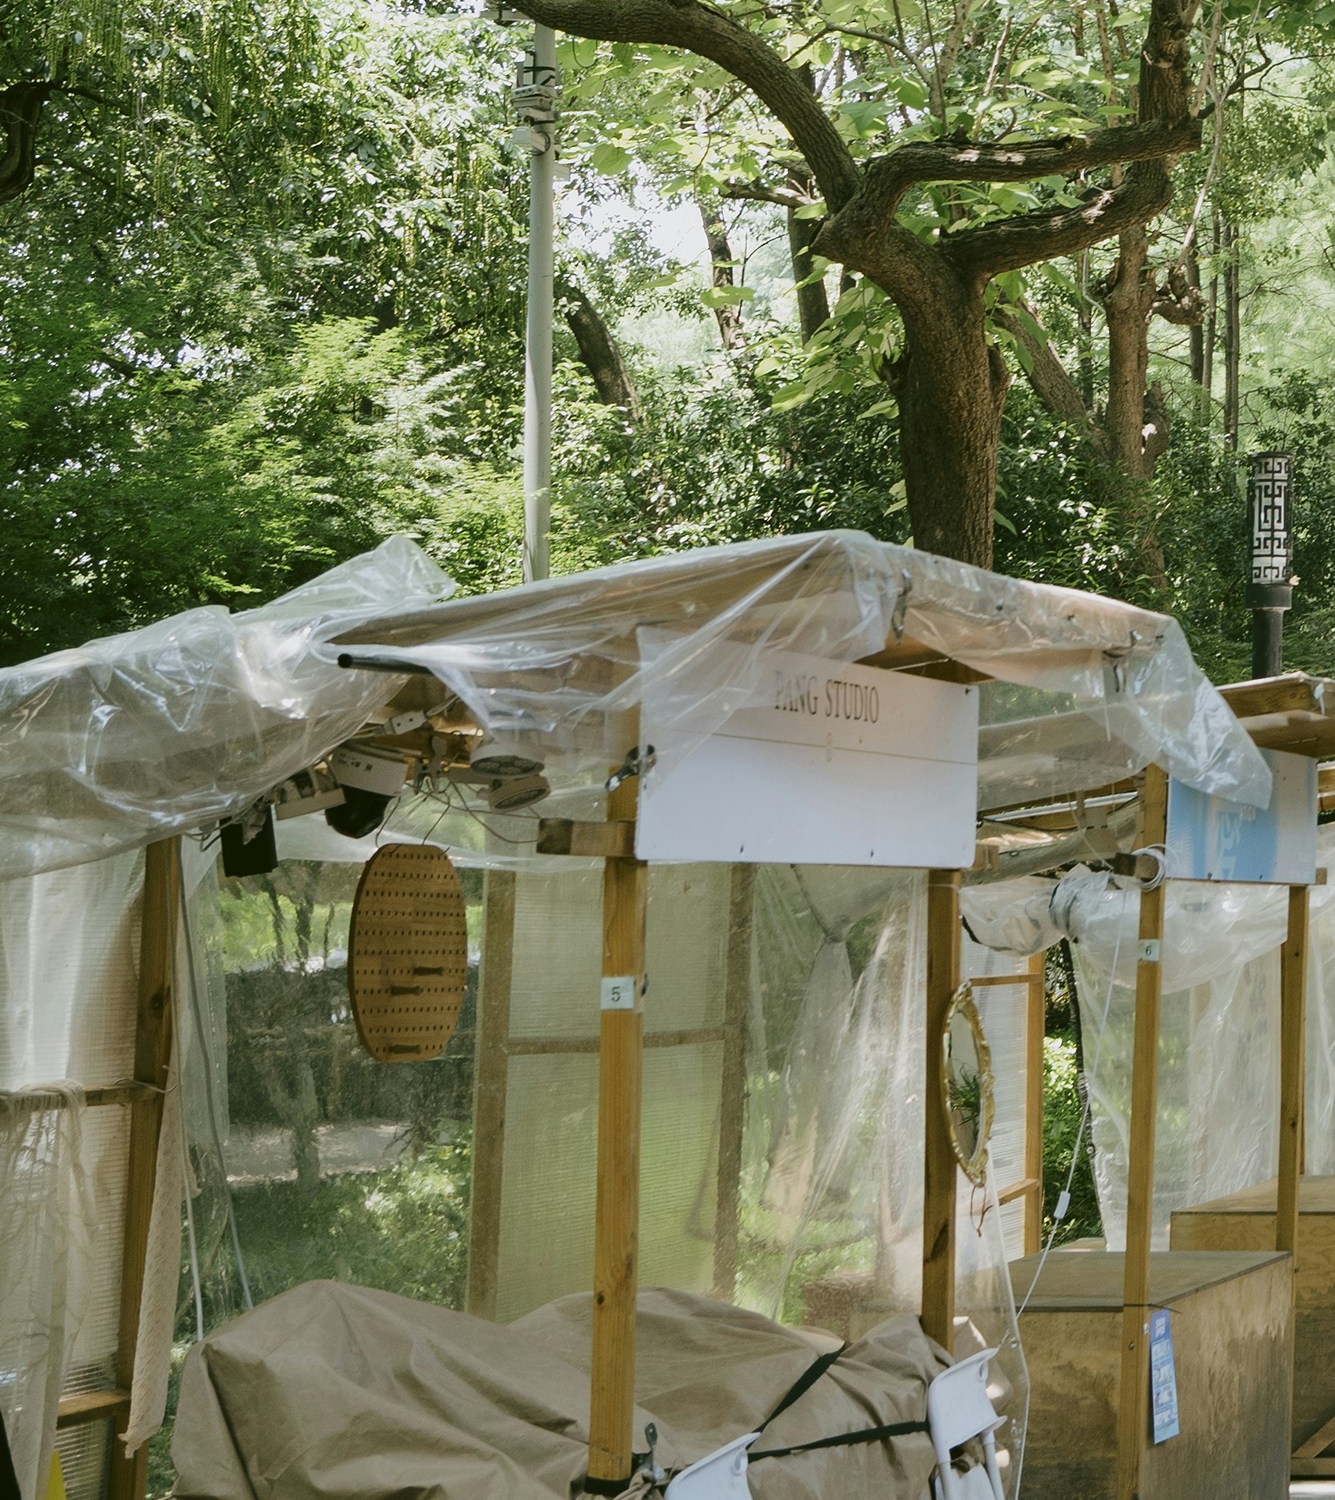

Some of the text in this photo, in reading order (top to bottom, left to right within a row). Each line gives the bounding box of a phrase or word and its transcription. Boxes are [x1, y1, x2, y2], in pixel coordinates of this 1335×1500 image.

[825, 678, 880, 724] STUDIO
[1144, 944, 1152, 956] 6
[611, 986, 622, 1002] 5
